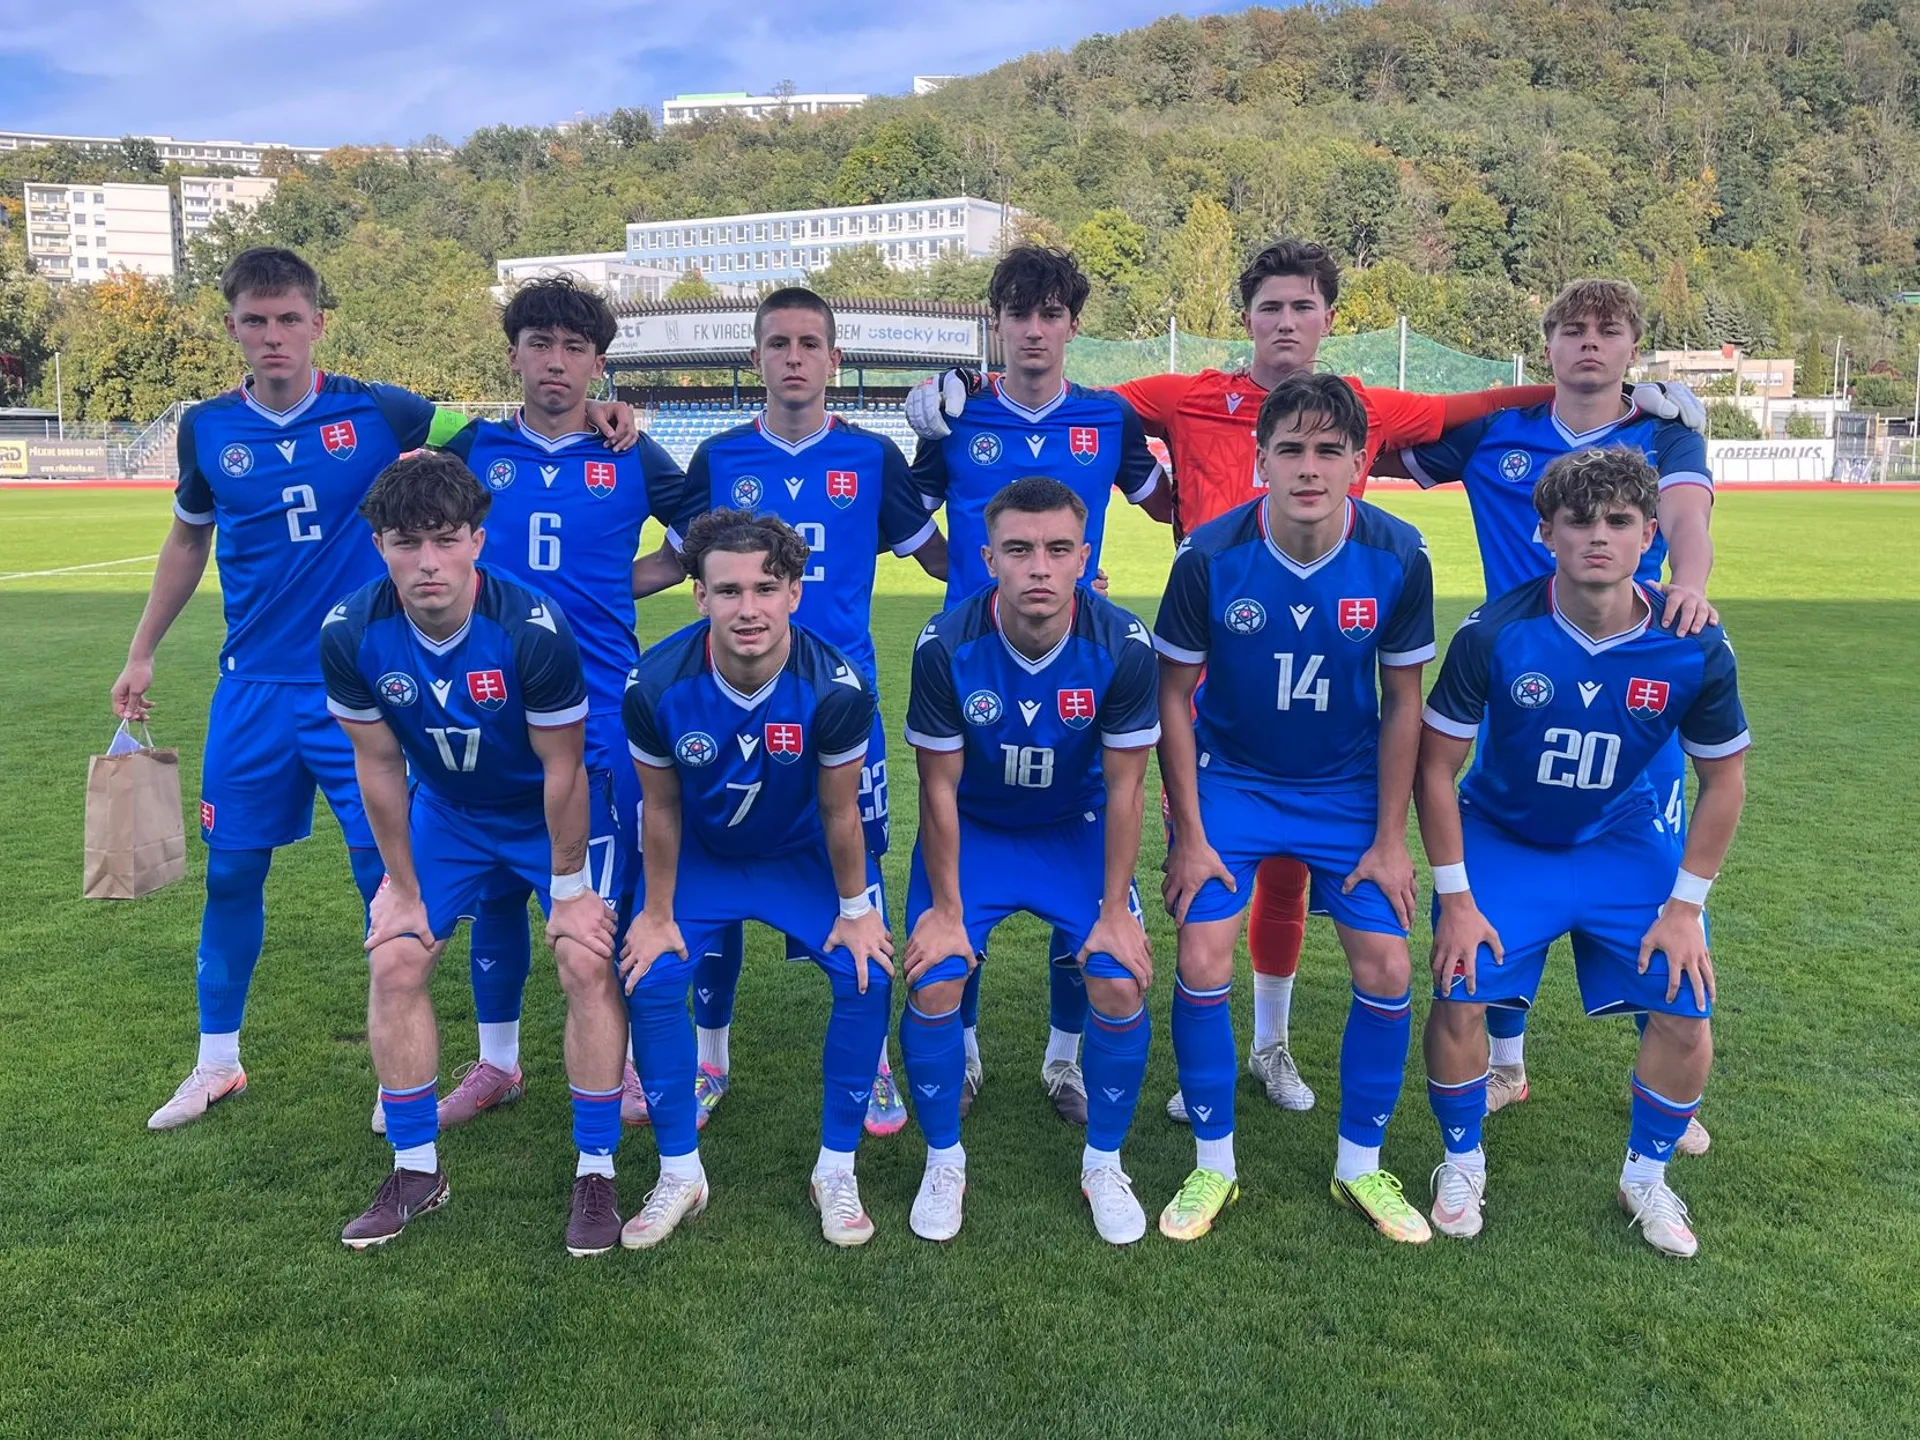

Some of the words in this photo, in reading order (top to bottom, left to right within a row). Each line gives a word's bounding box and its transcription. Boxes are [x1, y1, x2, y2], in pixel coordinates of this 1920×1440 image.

[693, 324, 710, 341] FK
[836, 324, 861, 340] BEM
[937, 328, 970, 346] kraj
[282, 484, 322, 542] 2
[528, 512, 562, 571] 6
[783, 522, 825, 581] 2
[1273, 652, 1330, 712] 14
[425, 726, 481, 772] 17
[1000, 743, 1055, 788] 18
[1536, 727, 1622, 790] 20
[726, 781, 762, 828] 7
